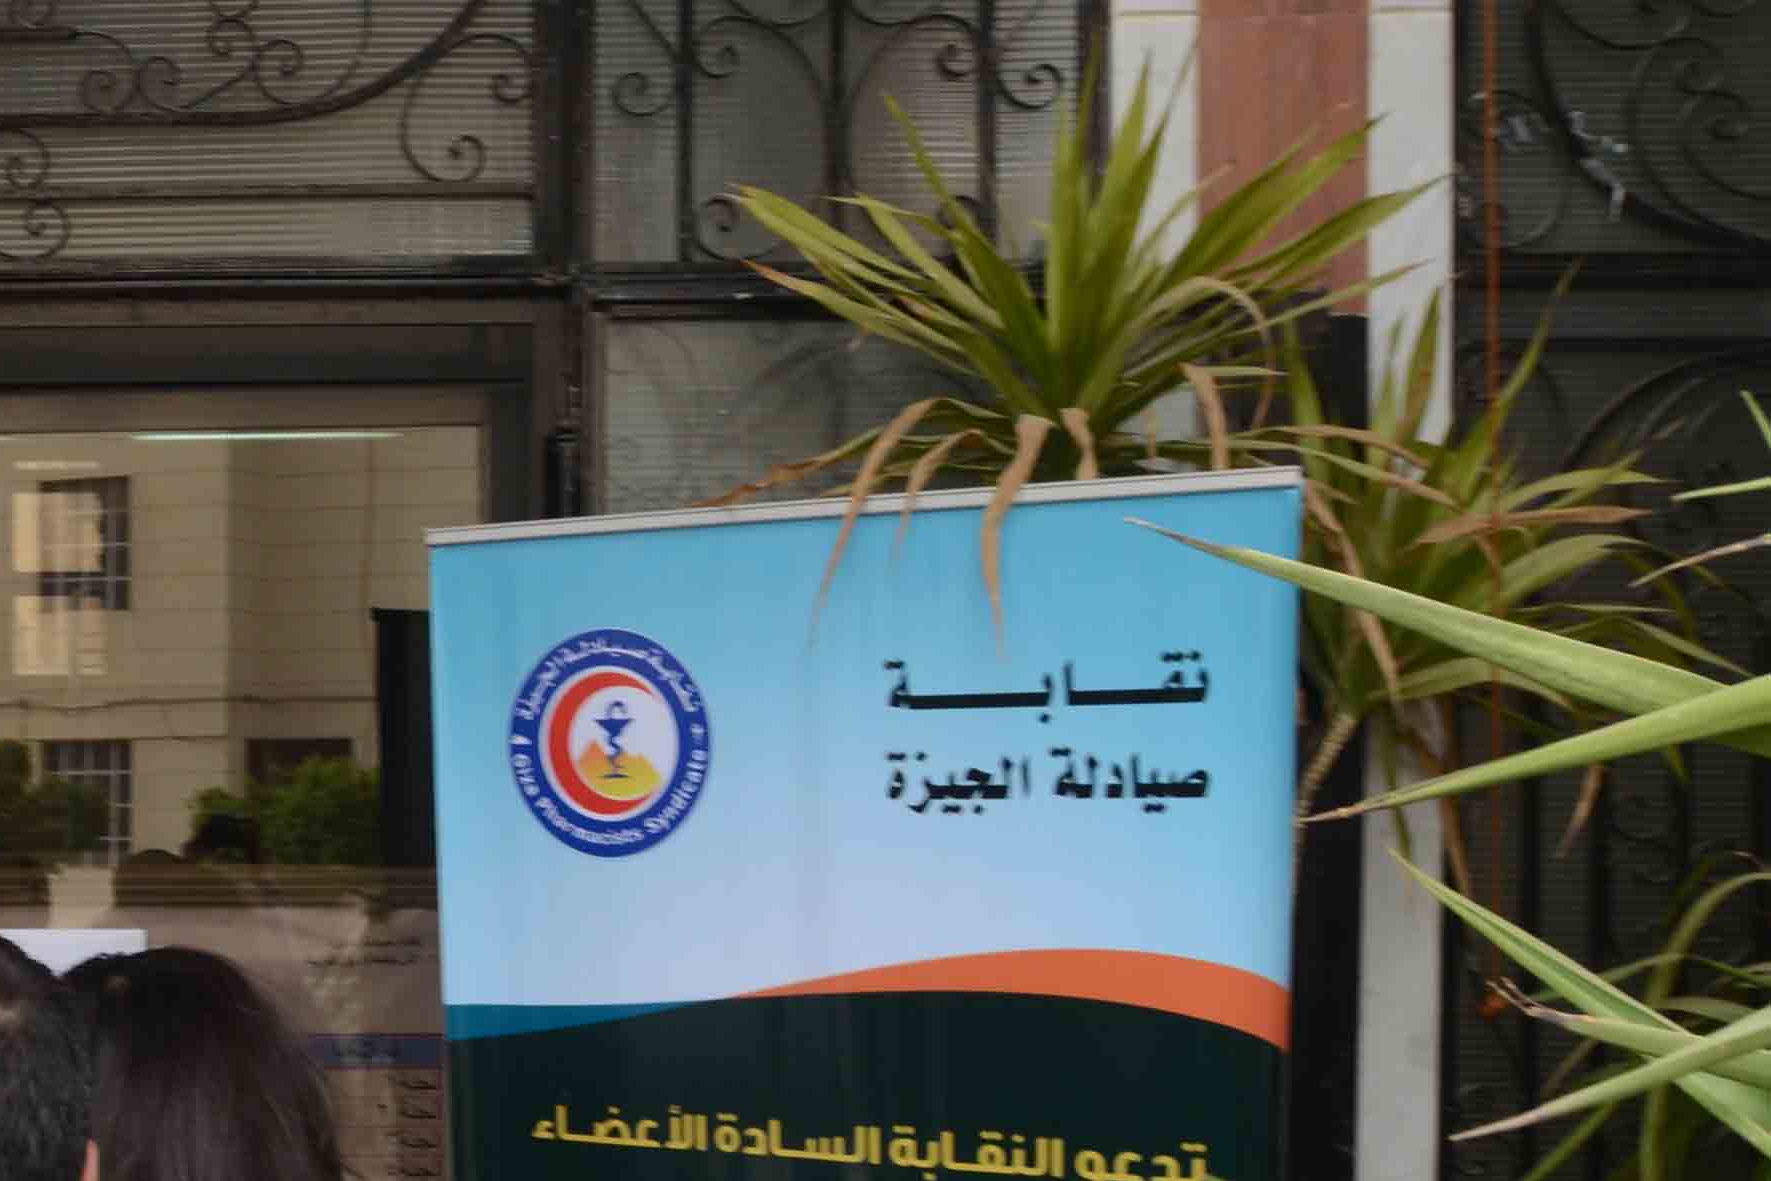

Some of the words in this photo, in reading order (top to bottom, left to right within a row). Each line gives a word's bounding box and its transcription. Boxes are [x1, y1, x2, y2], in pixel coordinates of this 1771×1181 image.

[884, 650, 1205, 724] نقابة
[886, 750, 1031, 815] الجيزة
[1048, 747, 1208, 814] صيادلة
[531, 1106, 708, 1150] الأعضاء
[714, 1114, 881, 1164] السادة
[889, 1126, 1064, 1181] النقابة
